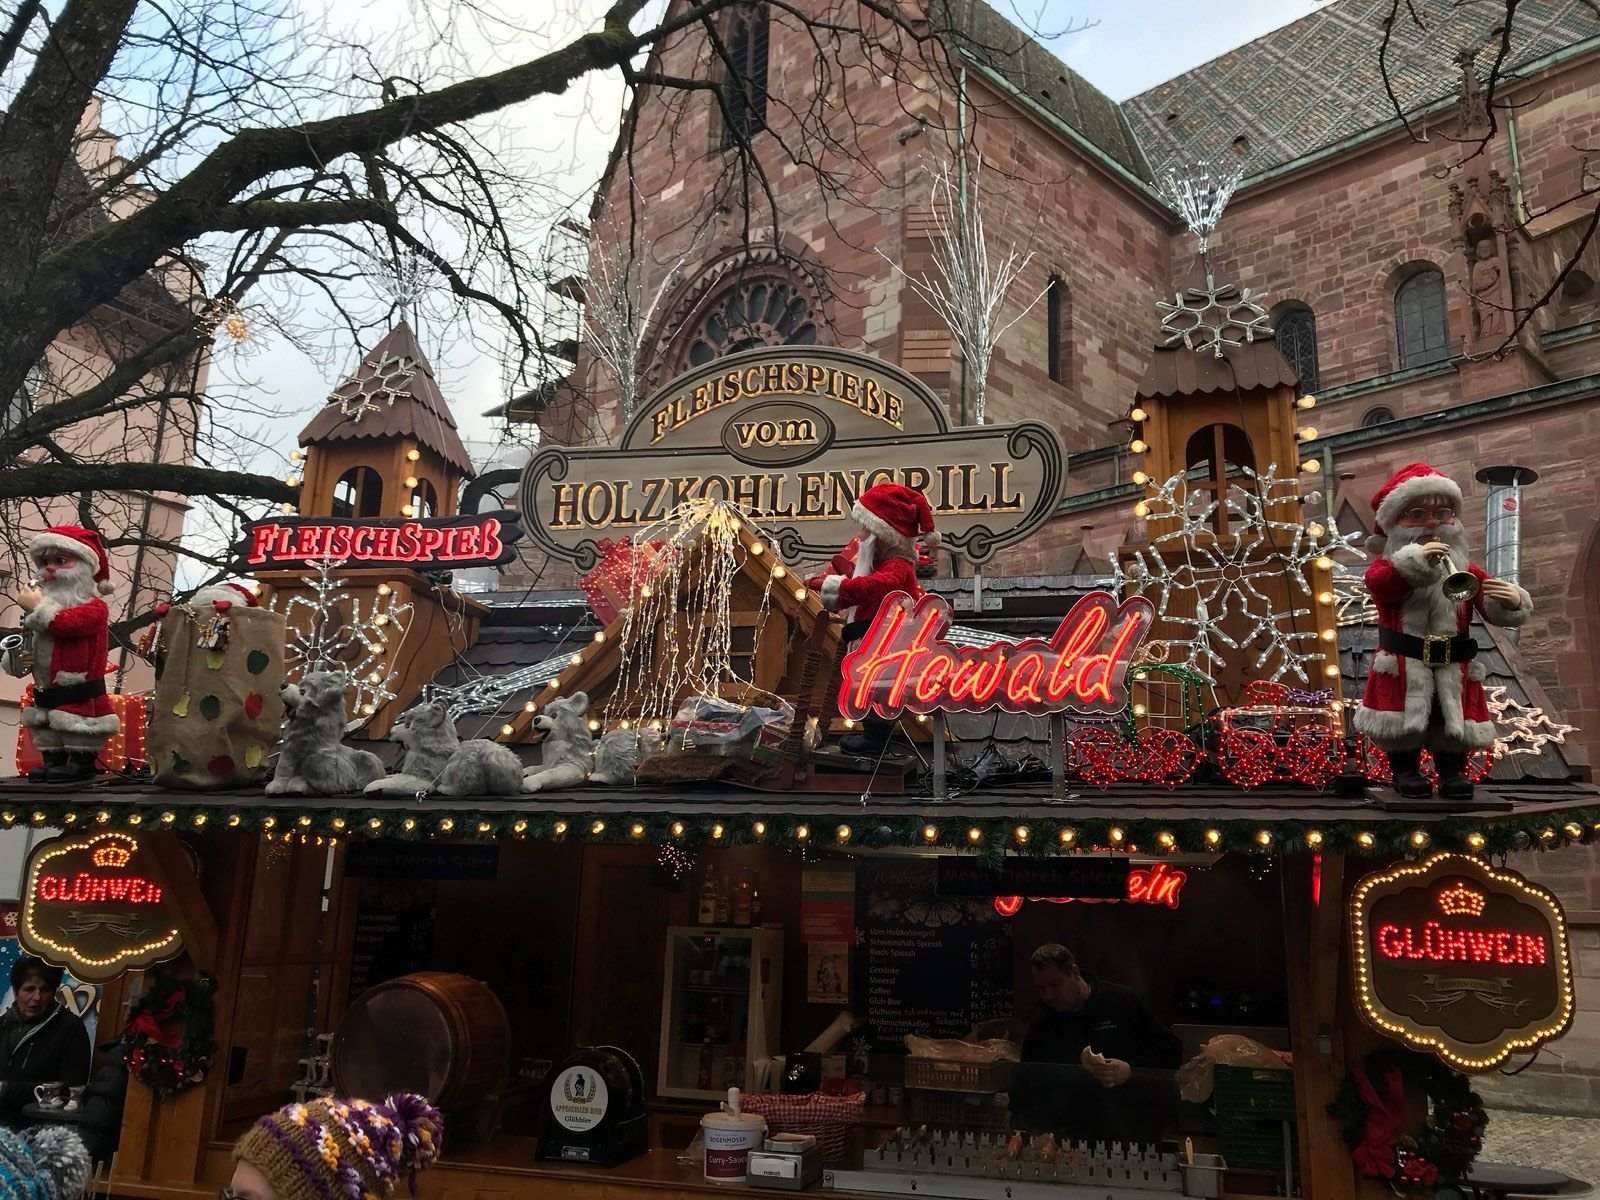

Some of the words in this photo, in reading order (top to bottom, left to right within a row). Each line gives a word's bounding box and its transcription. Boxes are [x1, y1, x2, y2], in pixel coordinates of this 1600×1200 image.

[733, 418, 818, 449] vom
[851, 600, 1143, 709] Howald
[1378, 921, 1547, 966] GLÜHWEIN
[869, 976, 896, 984] Mineral
[869, 987, 891, 995] Kaffee
